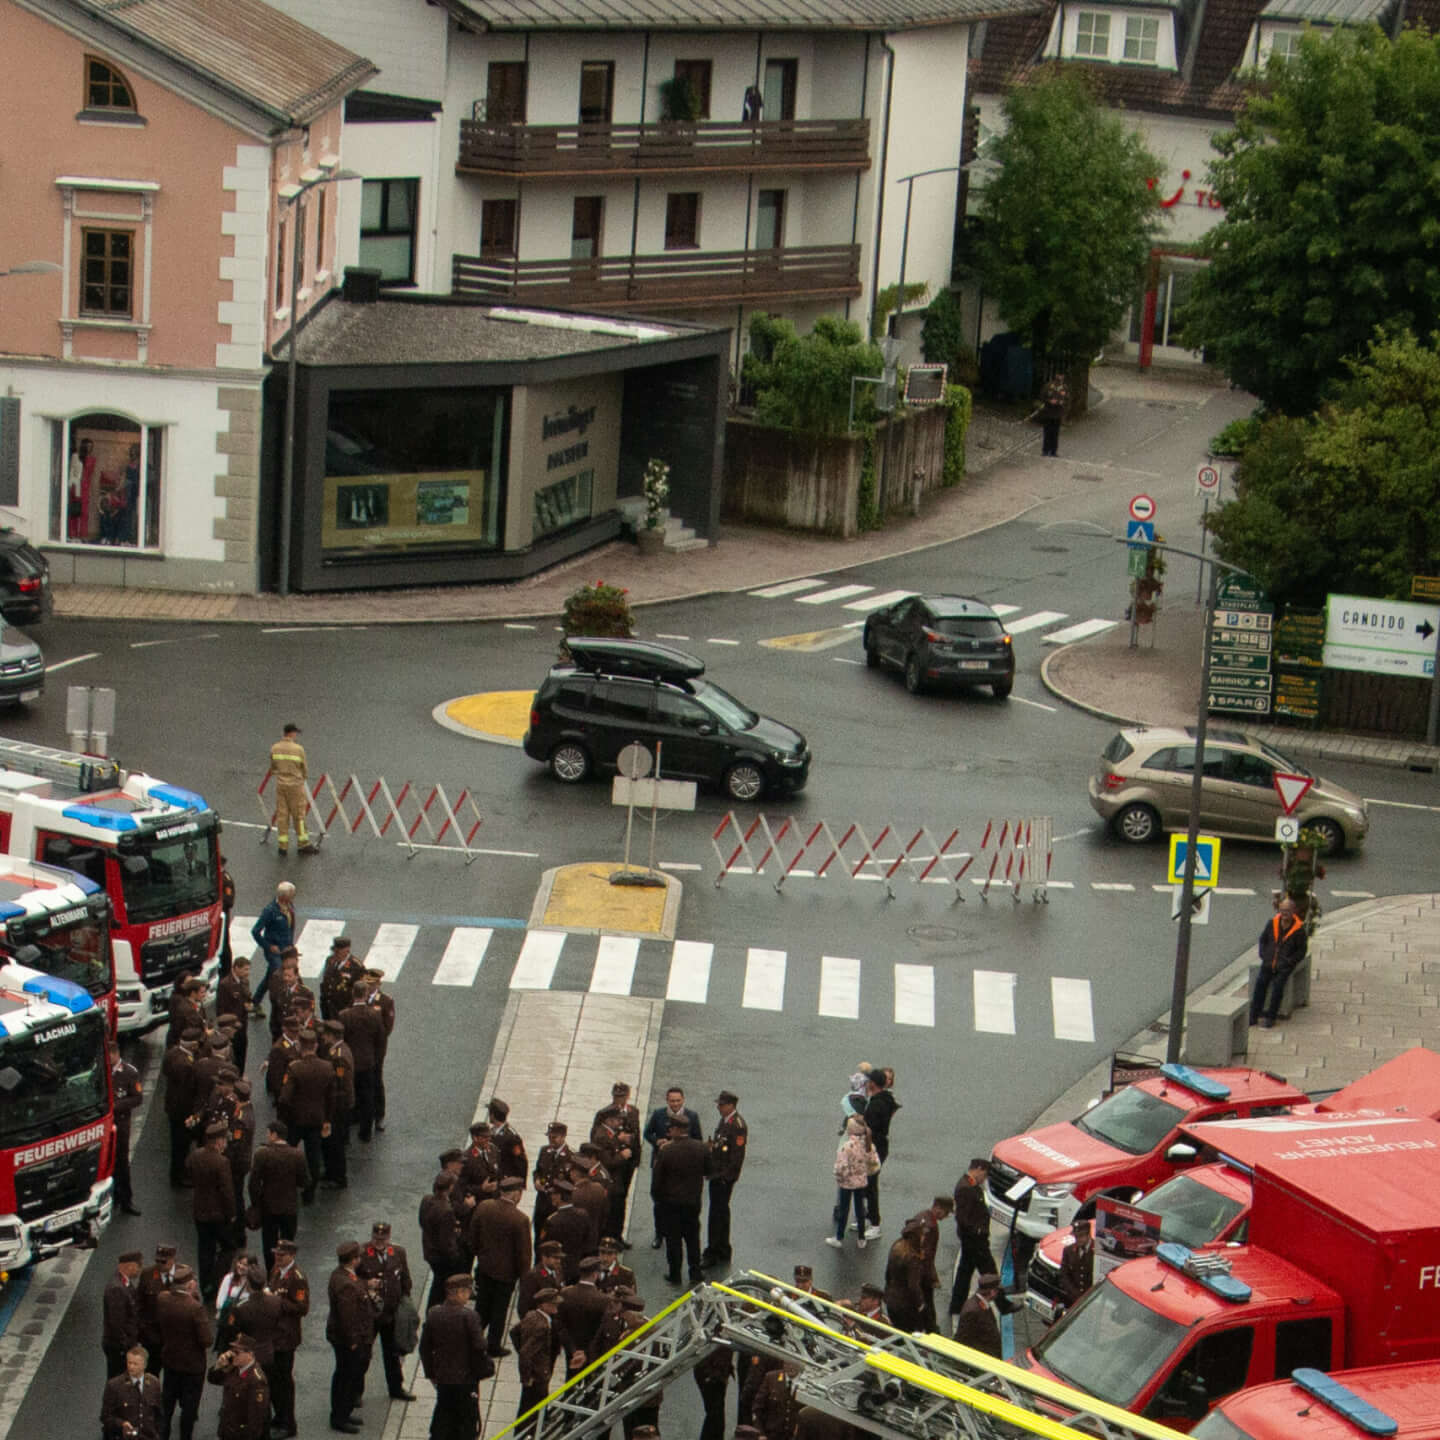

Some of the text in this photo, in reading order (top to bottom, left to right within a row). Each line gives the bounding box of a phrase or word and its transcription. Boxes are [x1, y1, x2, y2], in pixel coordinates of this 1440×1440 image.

[1195, 189, 1221, 209] TU
[1342, 611, 1405, 629] CANDIDO
[1211, 676, 1251, 686] BAHNHOF
[1217, 696, 1253, 705] SPAR
[50, 906, 88, 928] ALTENMARKT
[149, 912, 209, 939] FEUERWEHR
[34, 1023, 77, 1045] FLACHAU
[14, 1124, 105, 1167] FEUERWEHR
[1018, 1136, 1081, 1168] FEUERWEHR
